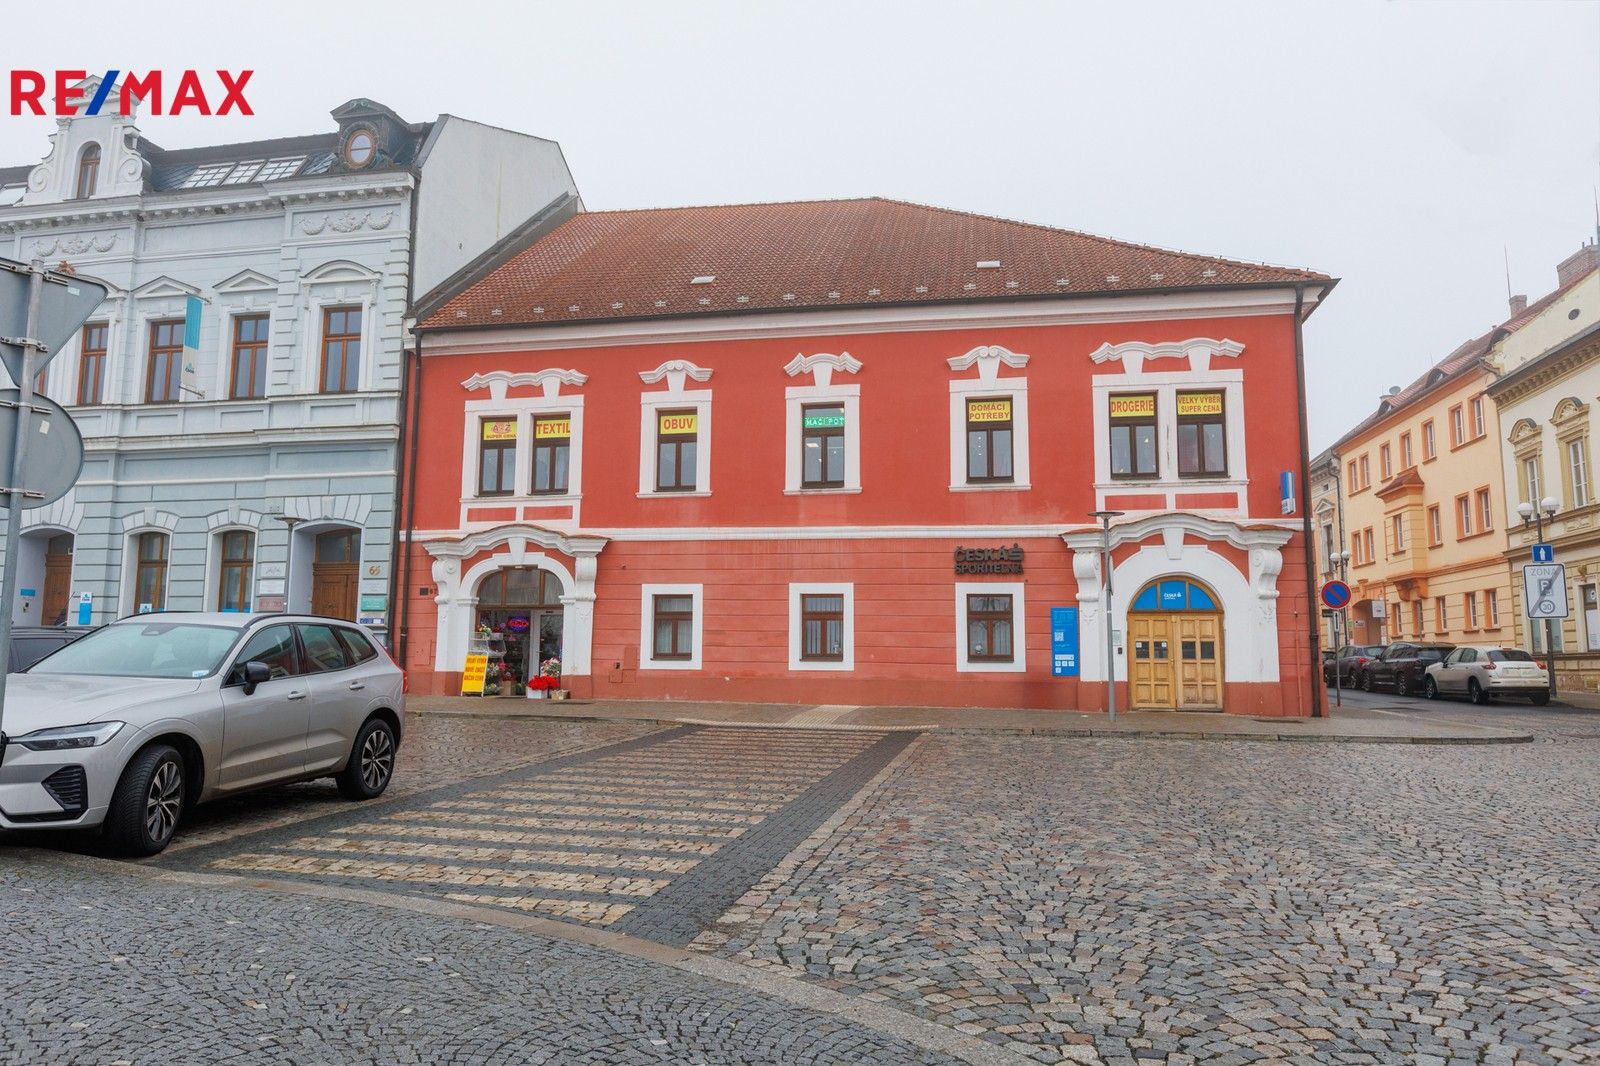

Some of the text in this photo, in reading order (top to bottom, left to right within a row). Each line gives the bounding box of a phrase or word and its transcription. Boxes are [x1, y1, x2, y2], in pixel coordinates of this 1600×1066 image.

[1111, 400, 1154, 413] DROGERIE
[536, 422, 570, 435] TEXTIL
[663, 418, 694, 430] OBUV
[955, 546, 1006, 561] ČESKÁ
[1542, 603, 1552, 611] 30
